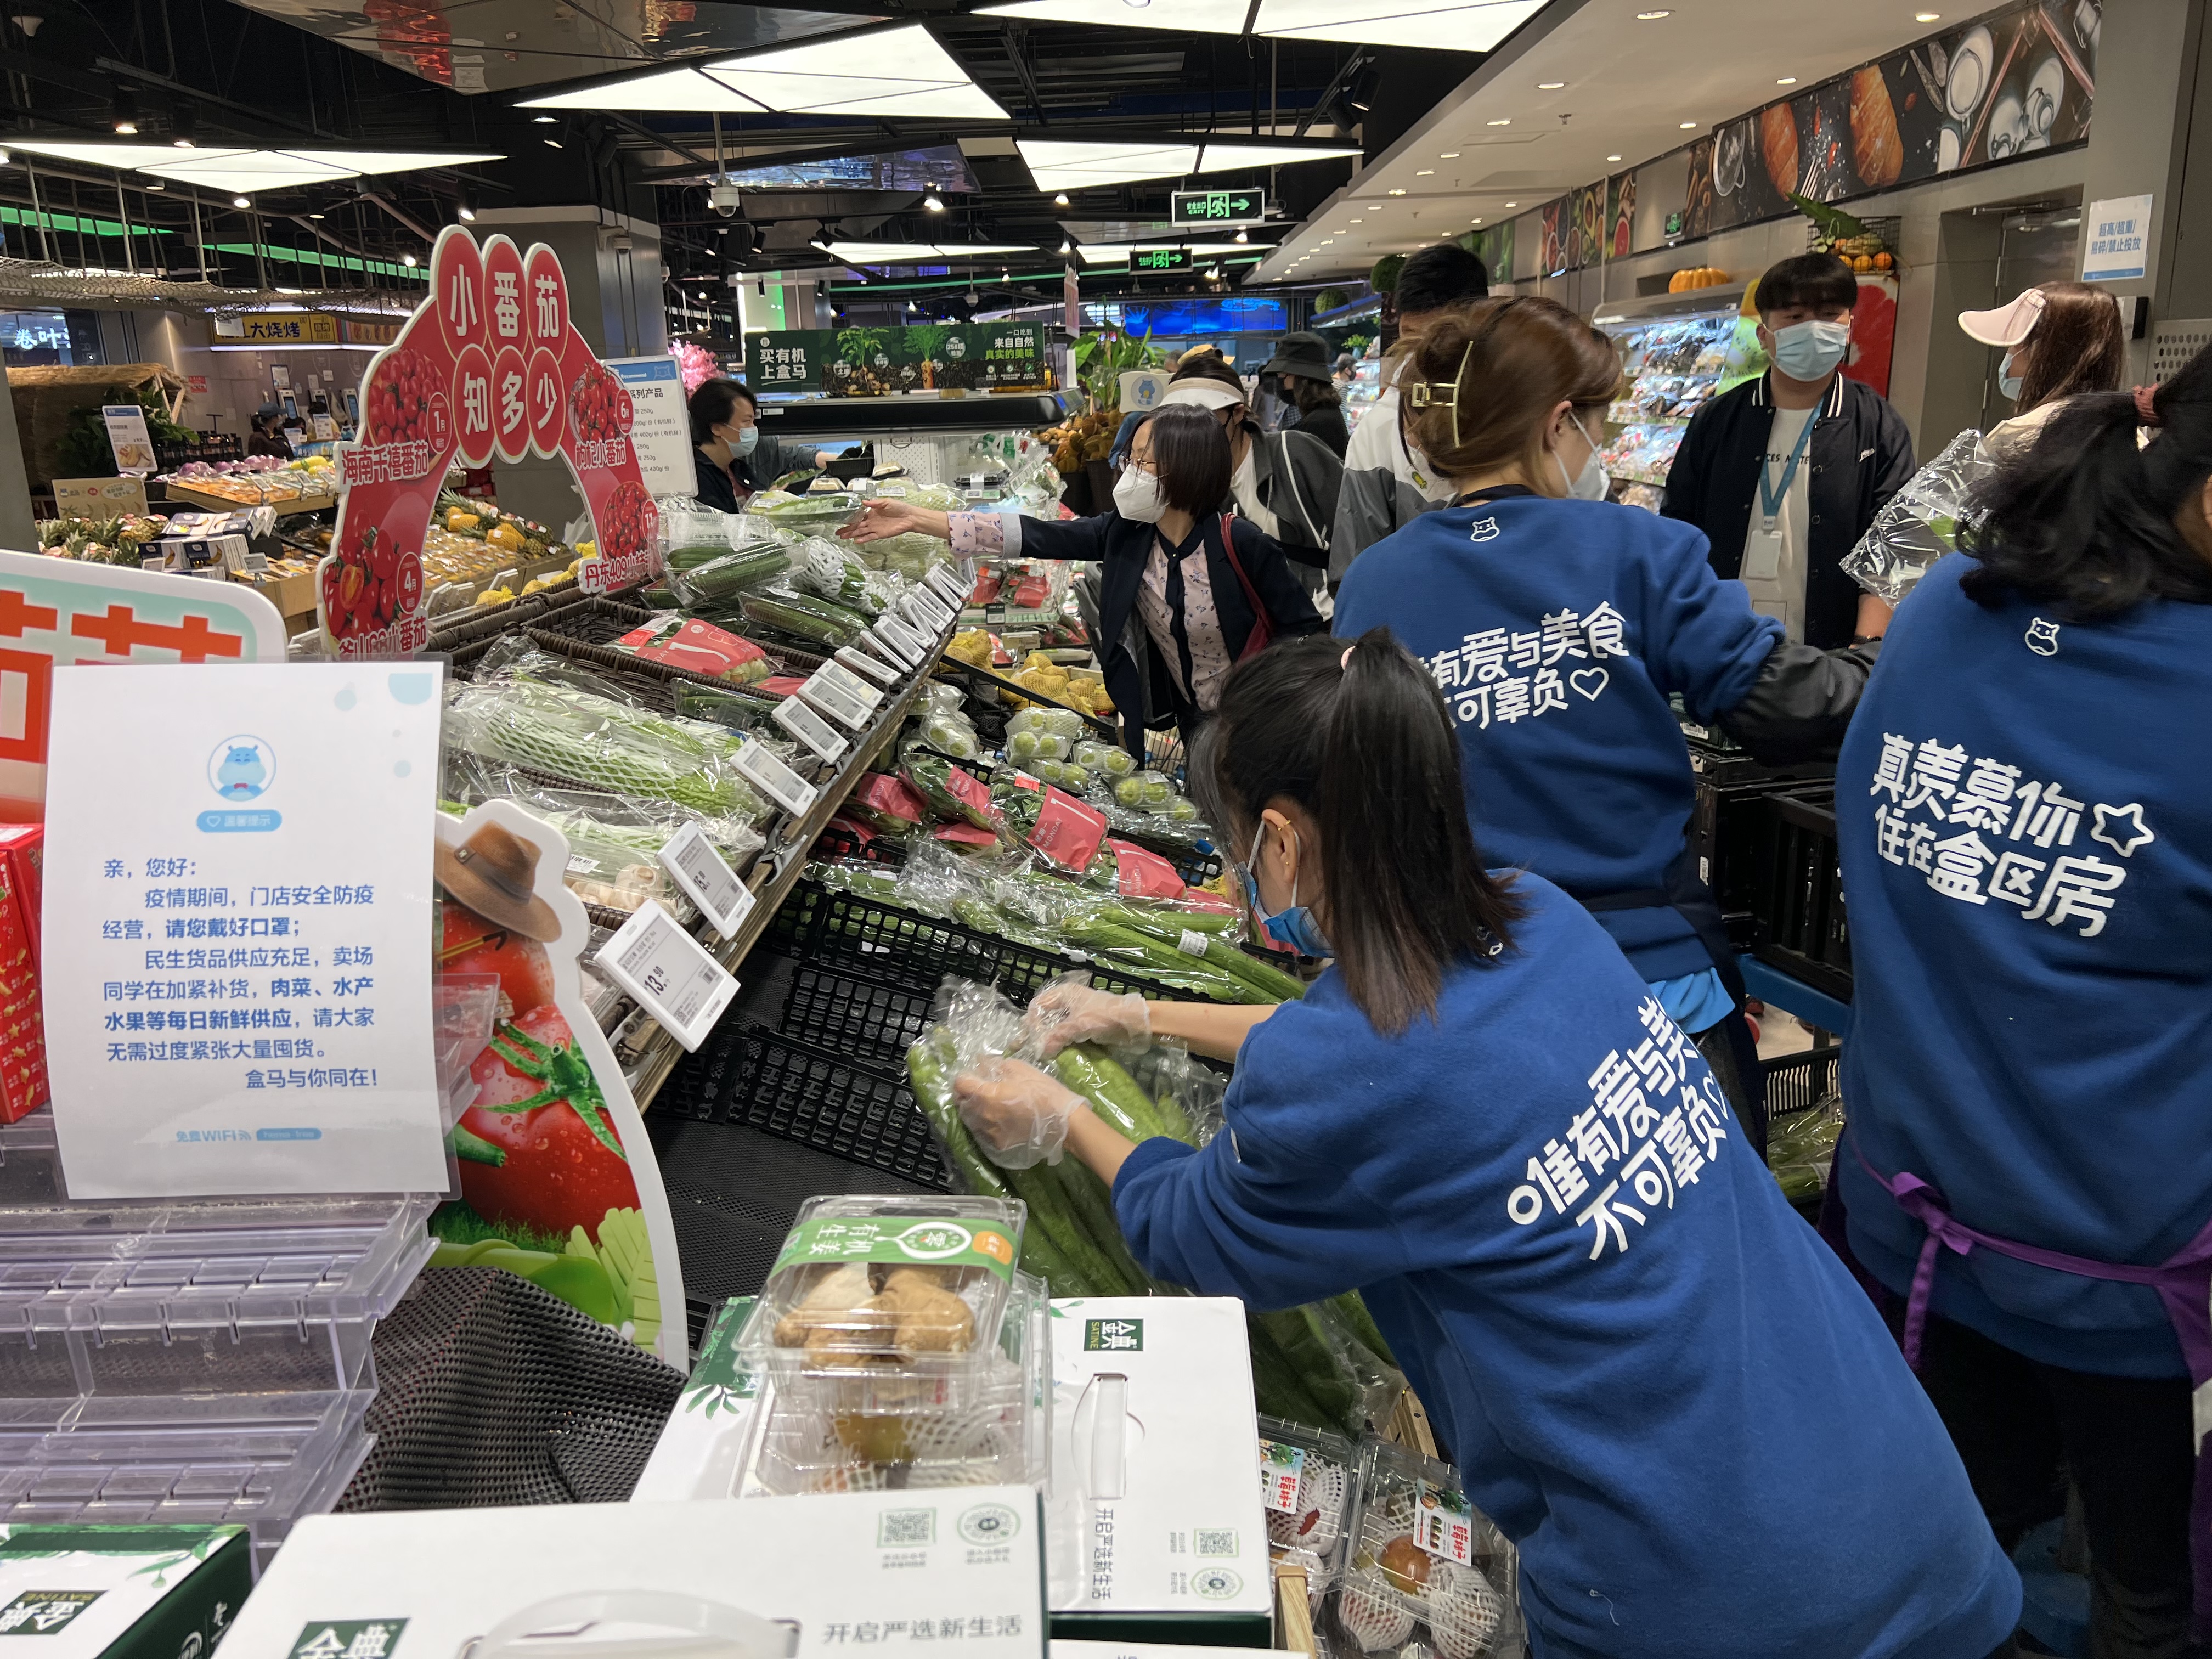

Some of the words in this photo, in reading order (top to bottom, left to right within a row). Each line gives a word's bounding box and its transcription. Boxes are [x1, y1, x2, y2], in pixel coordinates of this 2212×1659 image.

[450, 264, 560, 338] 小番茄
[221, 321, 301, 338] 大烧烤
[995, 337, 1034, 348] 来自自然
[760, 348, 806, 364] 买有机
[985, 348, 1035, 360] 真实的美味
[760, 364, 807, 380] 上盒马
[464, 370, 558, 435] 知多少
[631, 388, 663, 399] 系列产品
[434, 411, 445, 432] 1月
[620, 401, 630, 419] 6月
[342, 442, 428, 485] 海南千禧番茄
[576, 438, 626, 470] 枸杞小番茄
[404, 571, 416, 592] 4月
[1419, 600, 1630, 689] 有爱与美食
[1443, 667, 1569, 730] 可辜负
[1870, 732, 2085, 848] 真羡慕你
[1043, 817, 1063, 849] MONDAY
[1875, 804, 2127, 937] 住在盒区房
[144, 884, 375, 909] 疫情期间，门店安全防疫
[145, 946, 374, 970] 民生货品供应充足，卖场
[103, 976, 375, 1002] 同学在加紧补货，肉菜、水产
[104, 1007, 375, 1031] 水果等每日新鲜供应，请大家
[106, 1040, 327, 1062] 无需过度紧张大量囤货。
[1507, 995, 1700, 1225] 唯有爱与美
[1576, 1085, 1727, 1261] 不可辜负
[809, 1223, 847, 1256] 生姜
[845, 1223, 881, 1256] 有机
[1090, 1321, 1100, 1350] SATINE
[1092, 1508, 1114, 1600] 开启严选新生活
[1452, 1525, 1469, 1560] 草莓柿子
[825, 1615, 1022, 1645] 开启严选新生活
